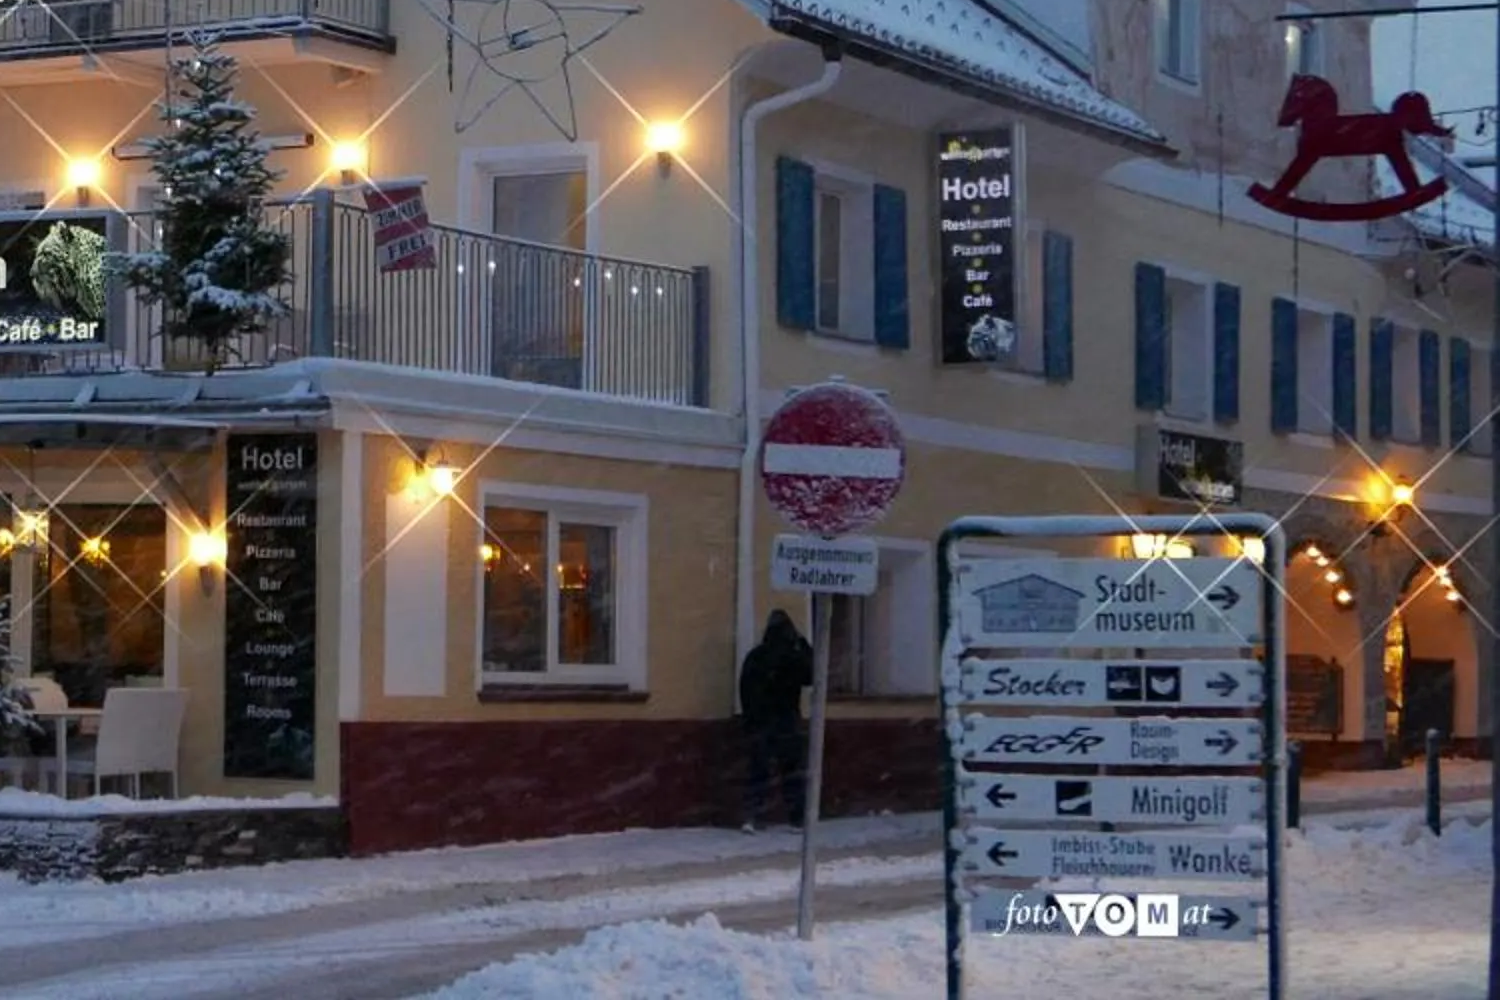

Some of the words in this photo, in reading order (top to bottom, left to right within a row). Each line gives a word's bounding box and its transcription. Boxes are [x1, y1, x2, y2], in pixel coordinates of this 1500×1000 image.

[942, 174, 1010, 201] Hotel
[941, 216, 1012, 232] Restaurant
[965, 268, 991, 282] Bar
[59, 317, 99, 340] Bar
[242, 445, 303, 471] Hotel
[1159, 432, 1196, 468] Hotel
[237, 512, 307, 527] Restaurant
[259, 576, 282, 591] Bar
[1095, 574, 1167, 603] Stadt-
[1095, 611, 1196, 633] museum
[245, 641, 296, 659] Lounge
[982, 665, 1087, 696] Stocker
[1130, 741, 1180, 762] Design
[1130, 785, 1229, 818] Minigolf
[1168, 844, 1252, 875] Wanke
